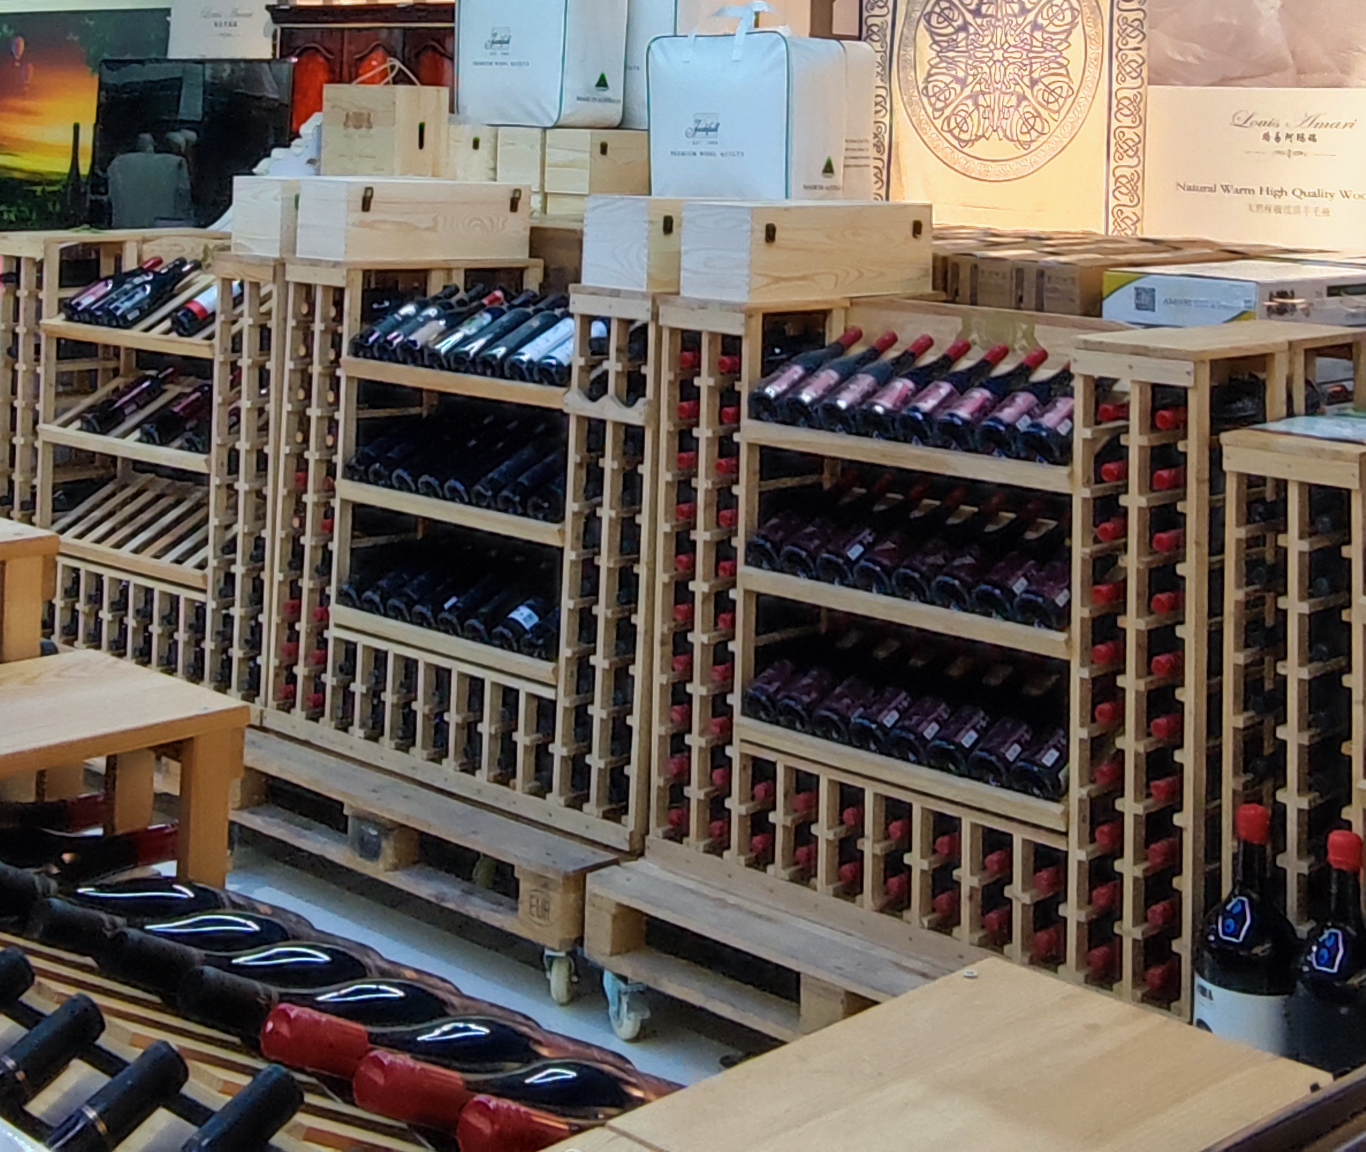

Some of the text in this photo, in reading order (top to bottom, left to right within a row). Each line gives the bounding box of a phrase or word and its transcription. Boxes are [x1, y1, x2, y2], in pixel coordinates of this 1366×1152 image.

[1229, 109, 1358, 131] Louis Amari
[1176, 181, 1217, 194] Natural
[1220, 184, 1255, 196] Warm
[1259, 186, 1288, 199] High
[1291, 187, 1336, 201] Quality
